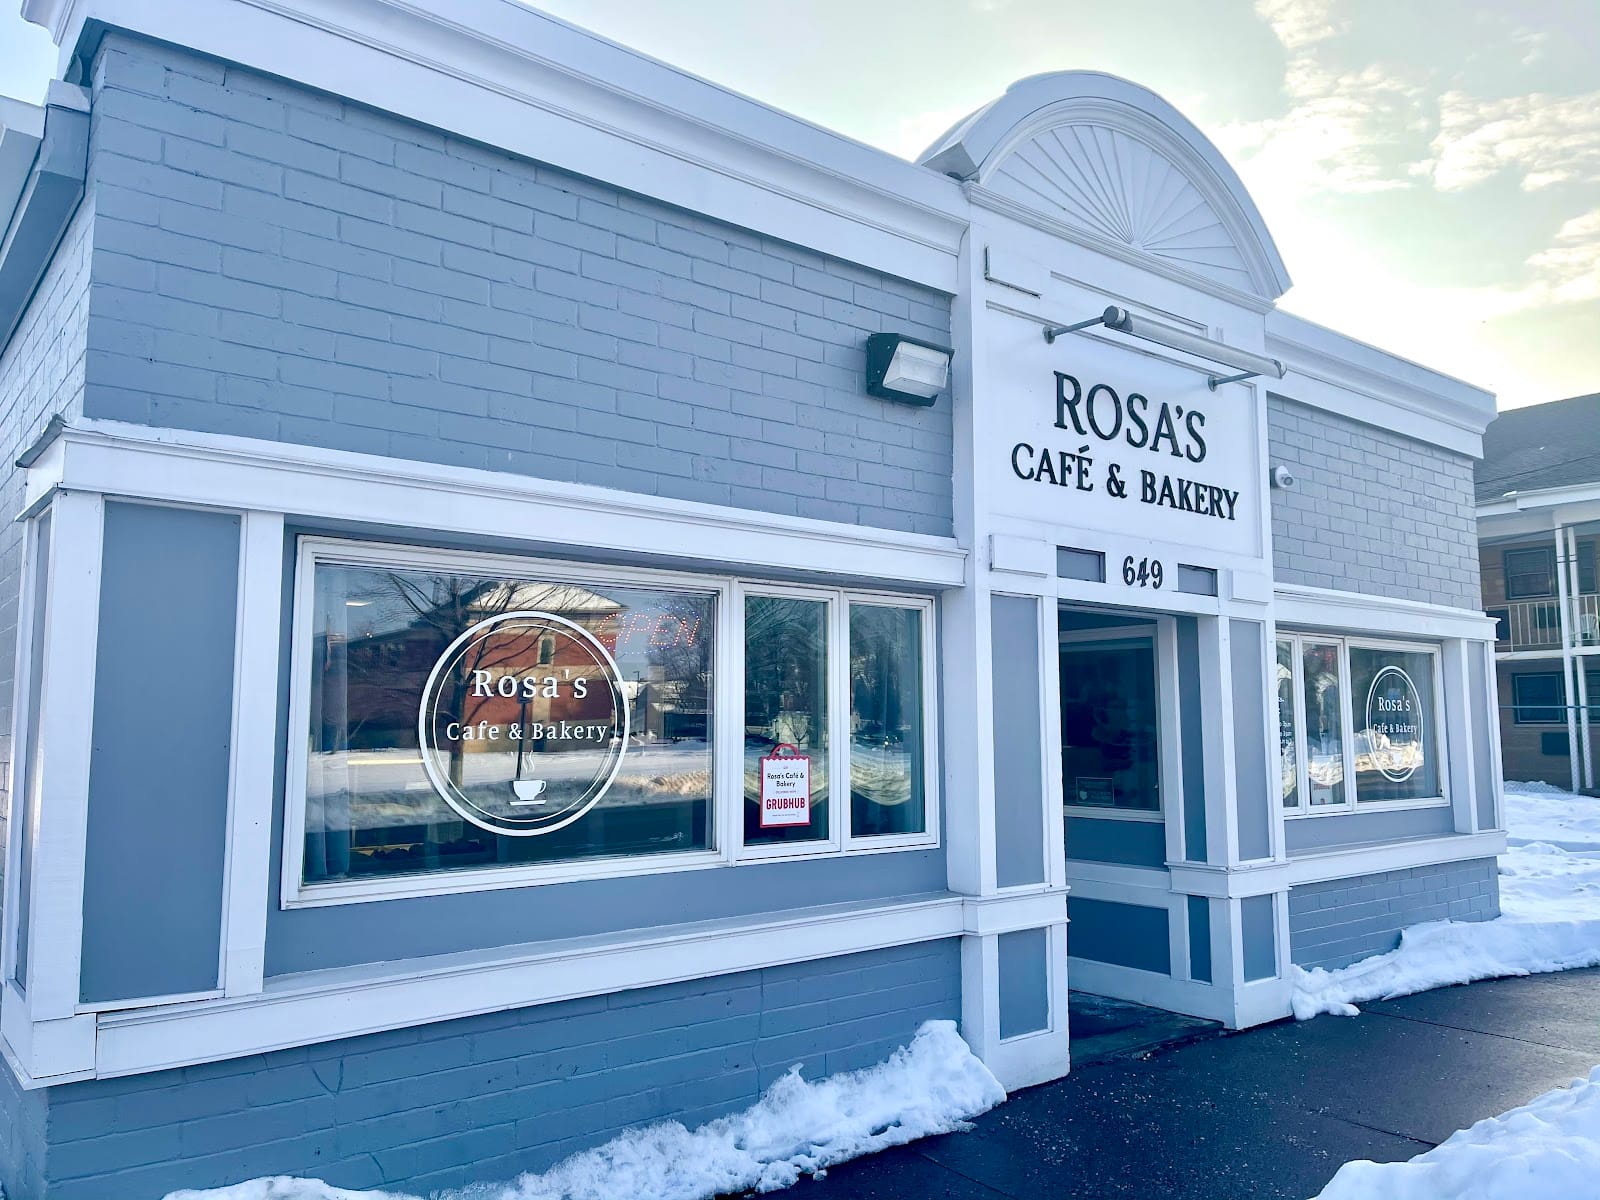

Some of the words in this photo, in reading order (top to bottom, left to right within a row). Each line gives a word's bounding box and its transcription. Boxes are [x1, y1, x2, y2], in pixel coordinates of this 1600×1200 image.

[1054, 371, 1206, 463] ROSA’S
[1011, 443, 1094, 492] CAFÉ
[1106, 463, 1128, 498] &
[1140, 469, 1240, 521] BAKERY
[1122, 555, 1163, 589] 649
[598, 613, 701, 647] OPEN
[471, 669, 588, 699] Rosa's
[1377, 695, 1411, 712] Rosa's
[446, 720, 500, 741] Cafe
[508, 723, 524, 740] &
[531, 720, 608, 743] Bakery
[1373, 722, 1388, 734] Cafe
[1389, 723, 1394, 733] &
[1395, 722, 1417, 735] Bakery
[776, 780, 796, 788] Bakery
[766, 797, 806, 810] GRUBHUB
